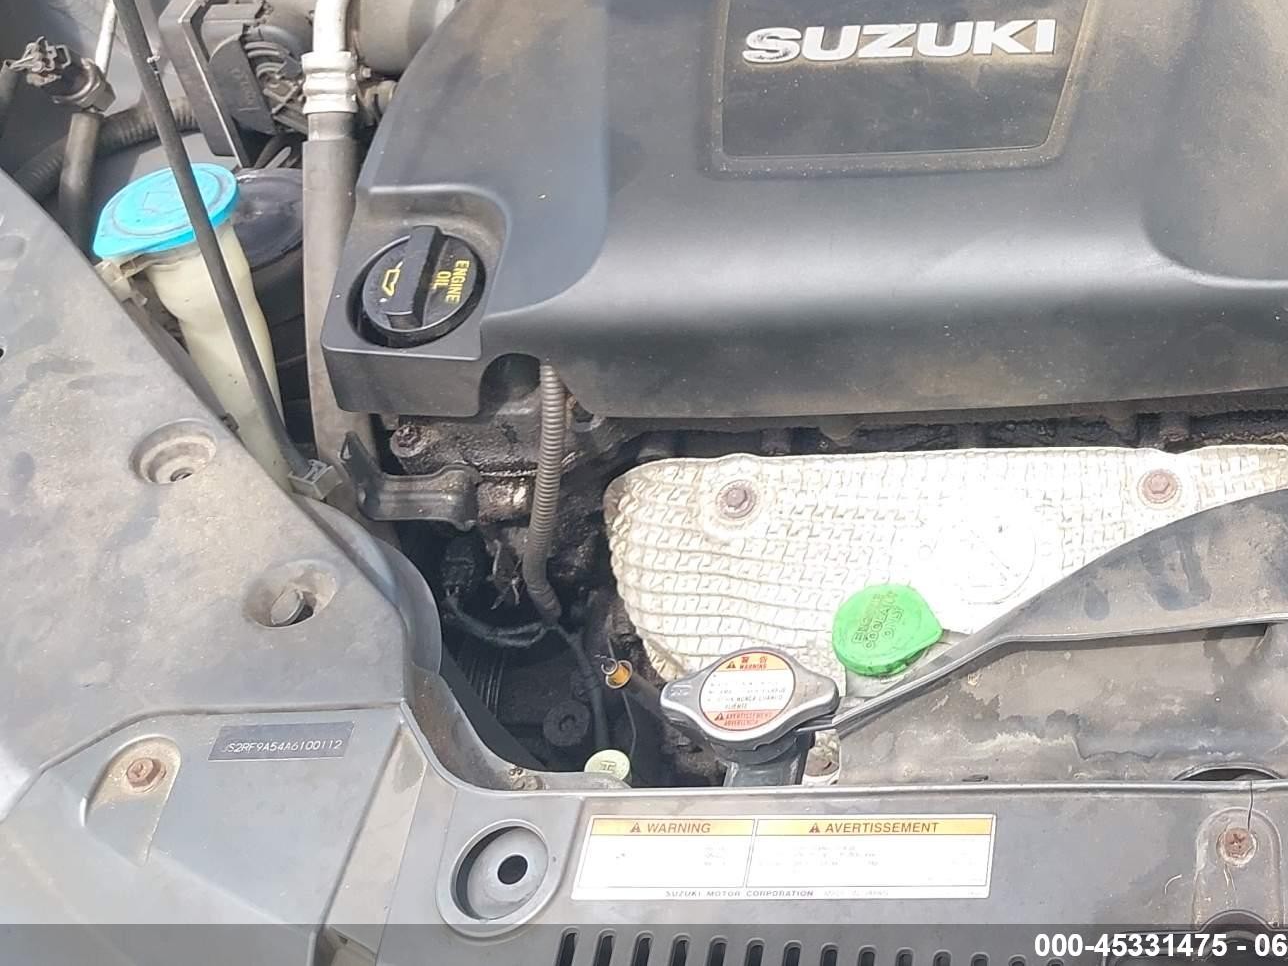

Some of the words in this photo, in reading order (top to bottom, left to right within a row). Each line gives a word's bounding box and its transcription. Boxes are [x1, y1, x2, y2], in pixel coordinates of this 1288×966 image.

[742, 18, 1056, 64] SUZUKI
[433, 270, 452, 291] OIL
[446, 259, 470, 304] ENGINE
[647, 822, 712, 834] WARNING
[825, 821, 940, 834] AVERTISSEMENT
